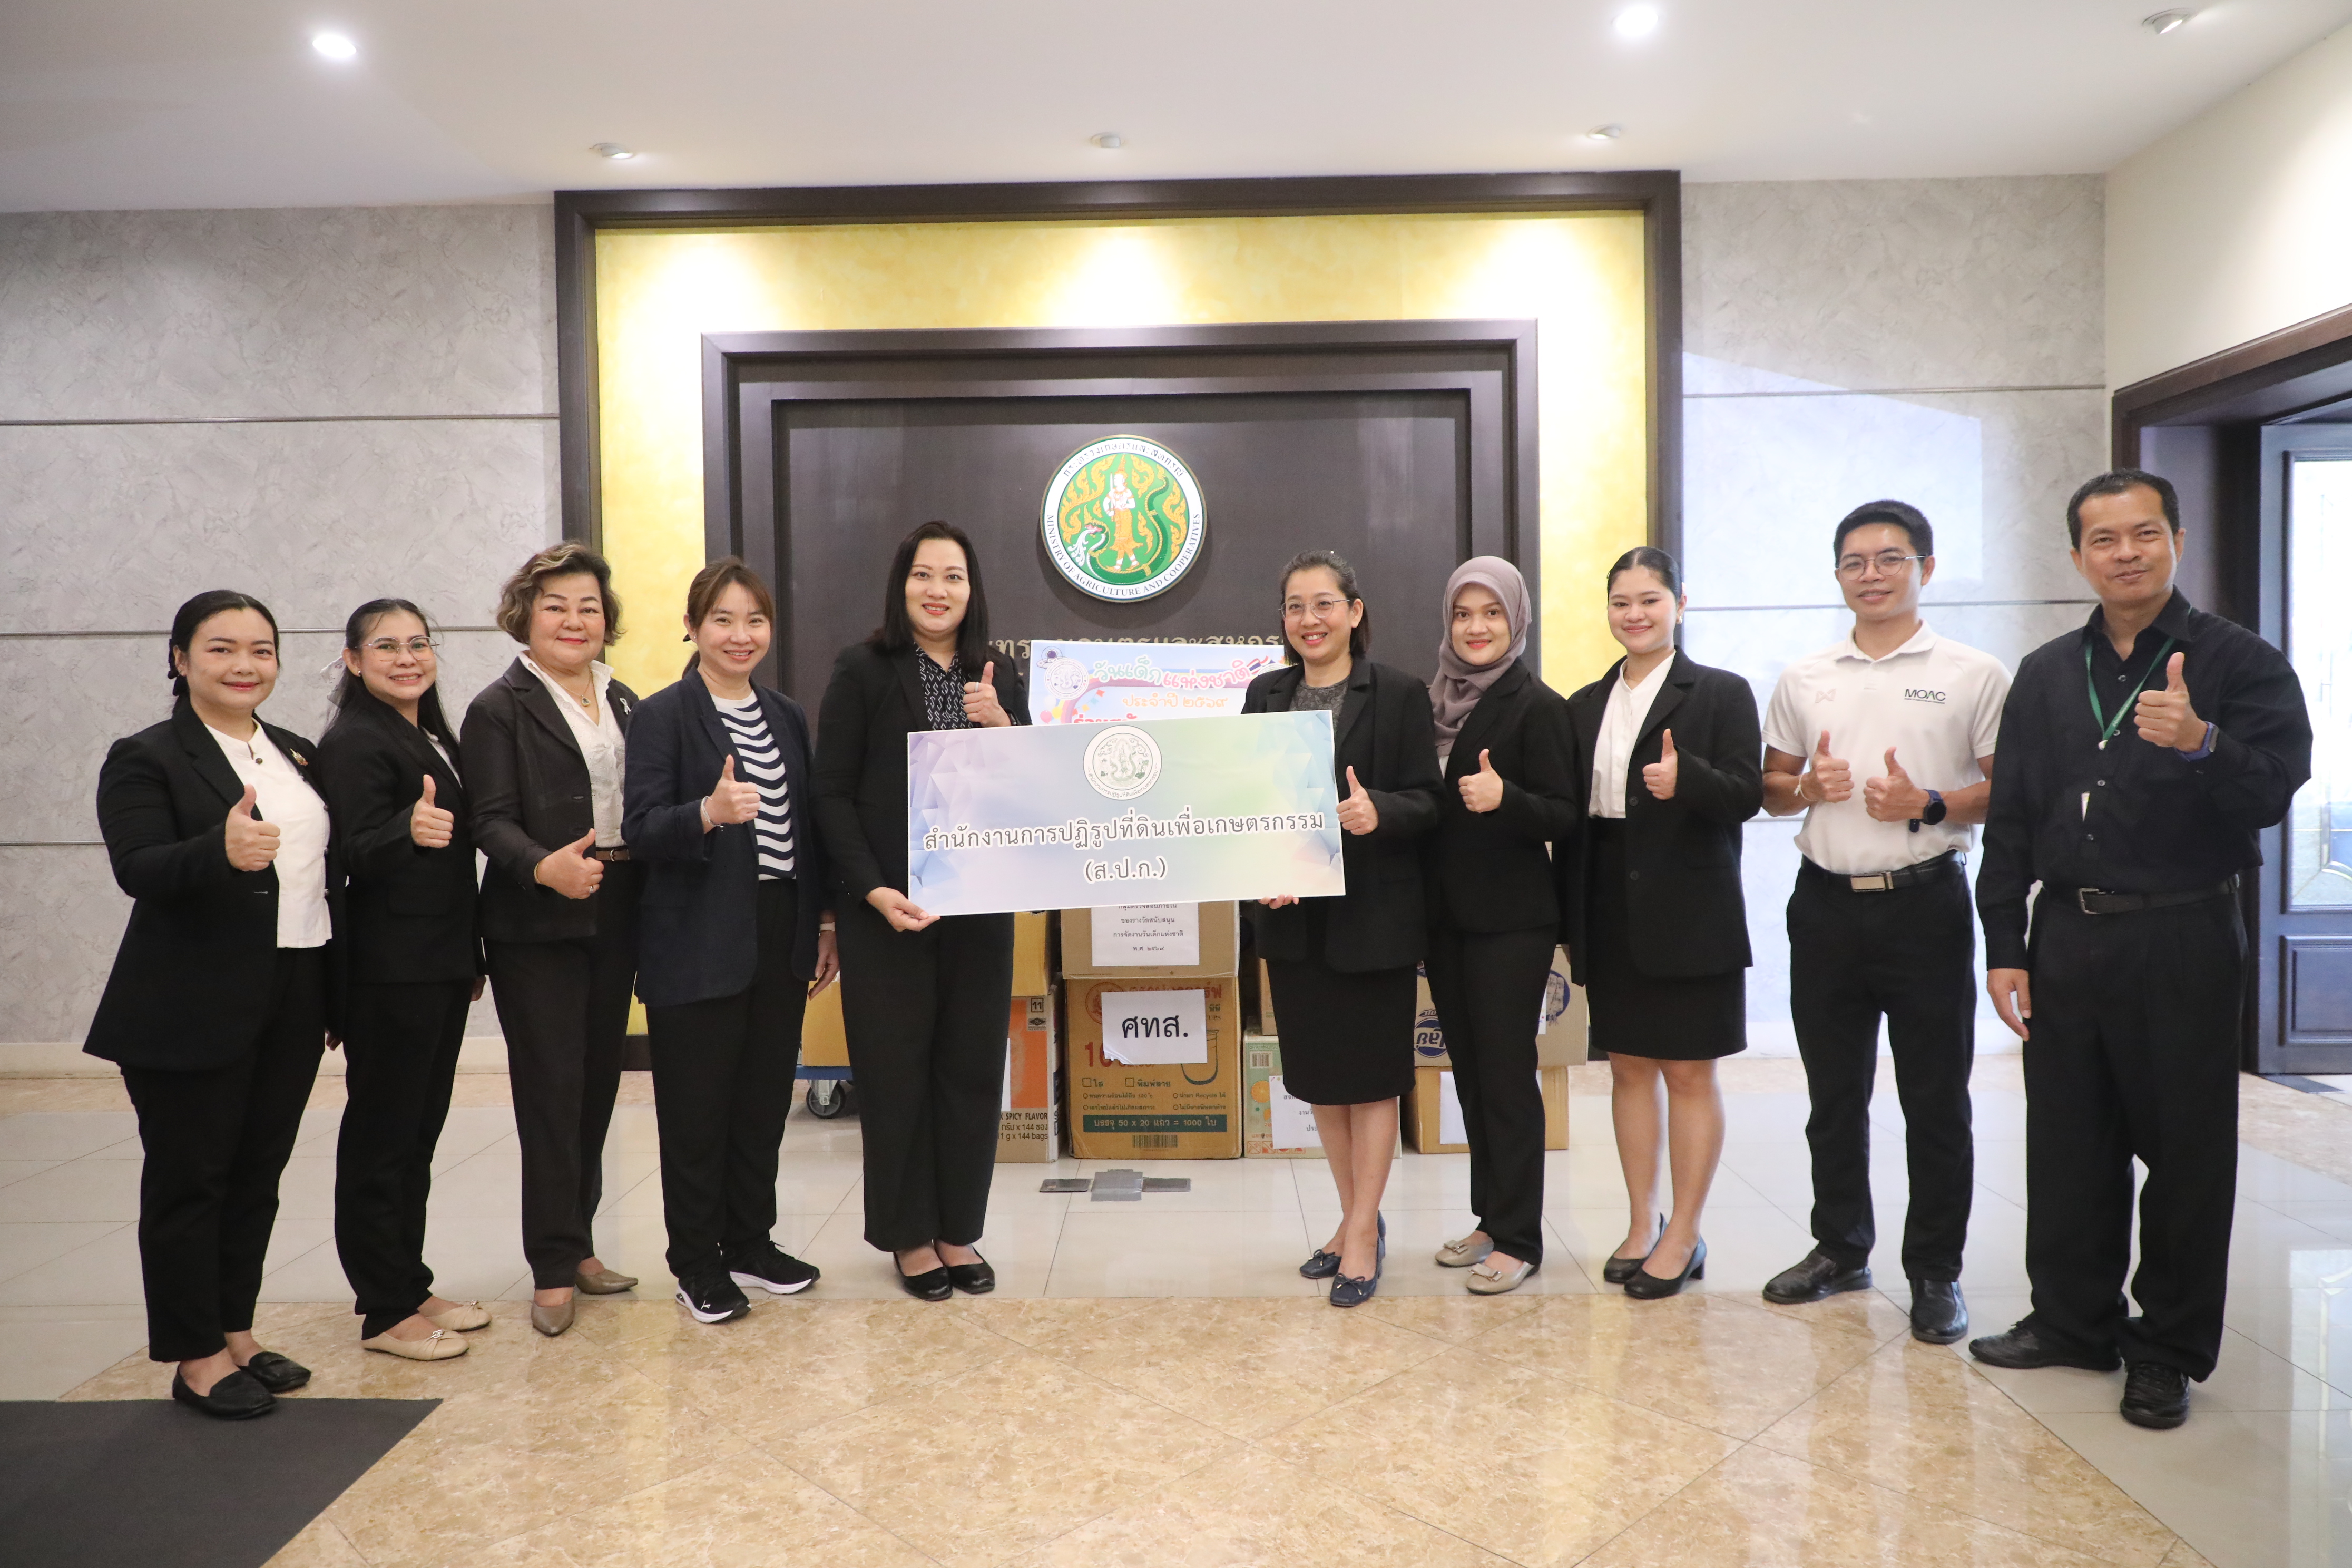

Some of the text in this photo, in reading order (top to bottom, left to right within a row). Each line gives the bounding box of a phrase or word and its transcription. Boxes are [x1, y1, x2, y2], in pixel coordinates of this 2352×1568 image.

[1063, 442, 1187, 477] กระทรวงเกษตรและสหกรณ์
[1047, 514, 1200, 596] MINISTRY OF AGRICULTURE AND COOPERATIVES
[1095, 656, 1250, 690] วันเด็กแห่งชาติ
[1123, 693, 1178, 708] ประจำปี
[1905, 689, 1946, 701] MOAC
[924, 805, 1324, 850] สำนักงานการปฏิรูปที่ดินเพื่อเกษตรกรรม
[1084, 857, 1167, 882] (ส.ป.ก.)
[1122, 1015, 1188, 1038] ศทส.
[1094, 1119, 1115, 1129] บรรจุ
